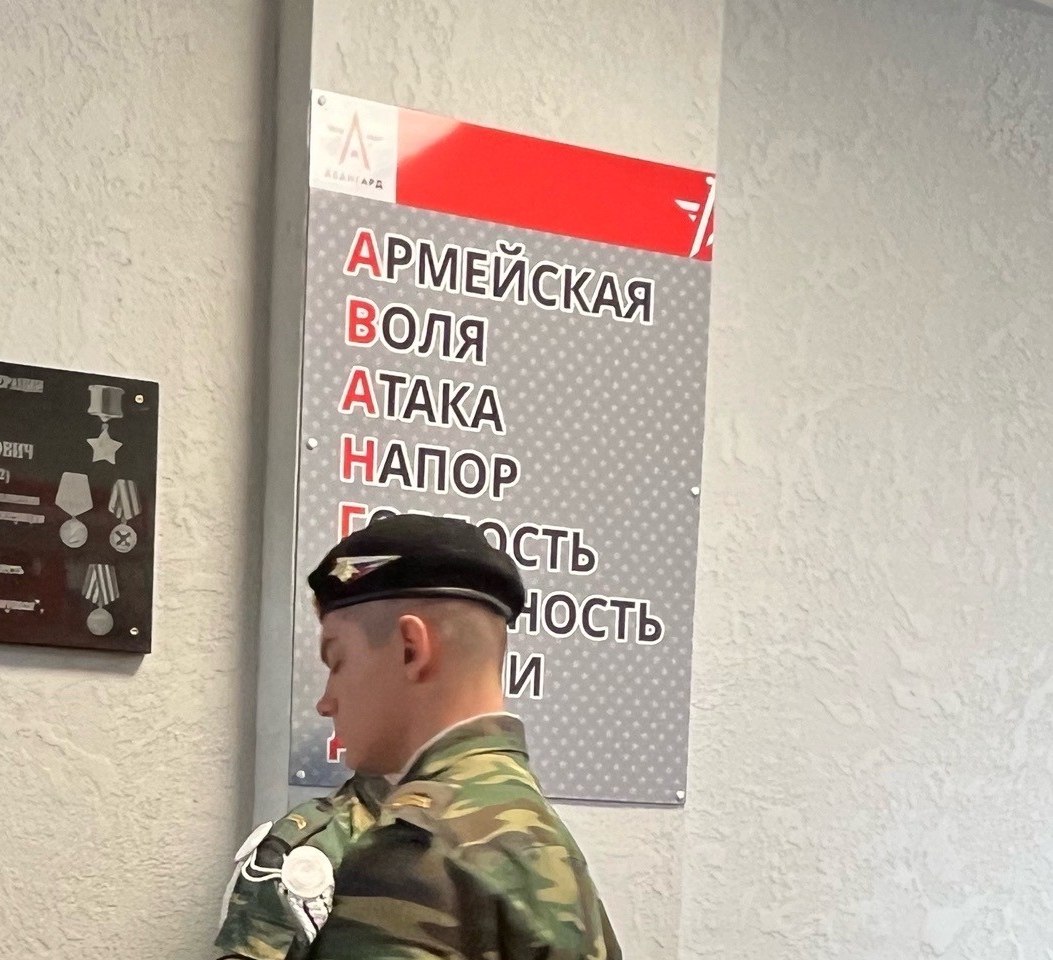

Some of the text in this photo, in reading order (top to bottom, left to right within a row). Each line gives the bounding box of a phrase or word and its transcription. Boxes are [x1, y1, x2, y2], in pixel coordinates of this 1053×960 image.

[346, 231, 653, 323] АРМЕЙСКАЯ
[347, 299, 485, 363] ВОЛЯ
[341, 369, 504, 433] АТАКА
[342, 437, 518, 498] НАПОР
[340, 504, 597, 573] ГОСТЬ
